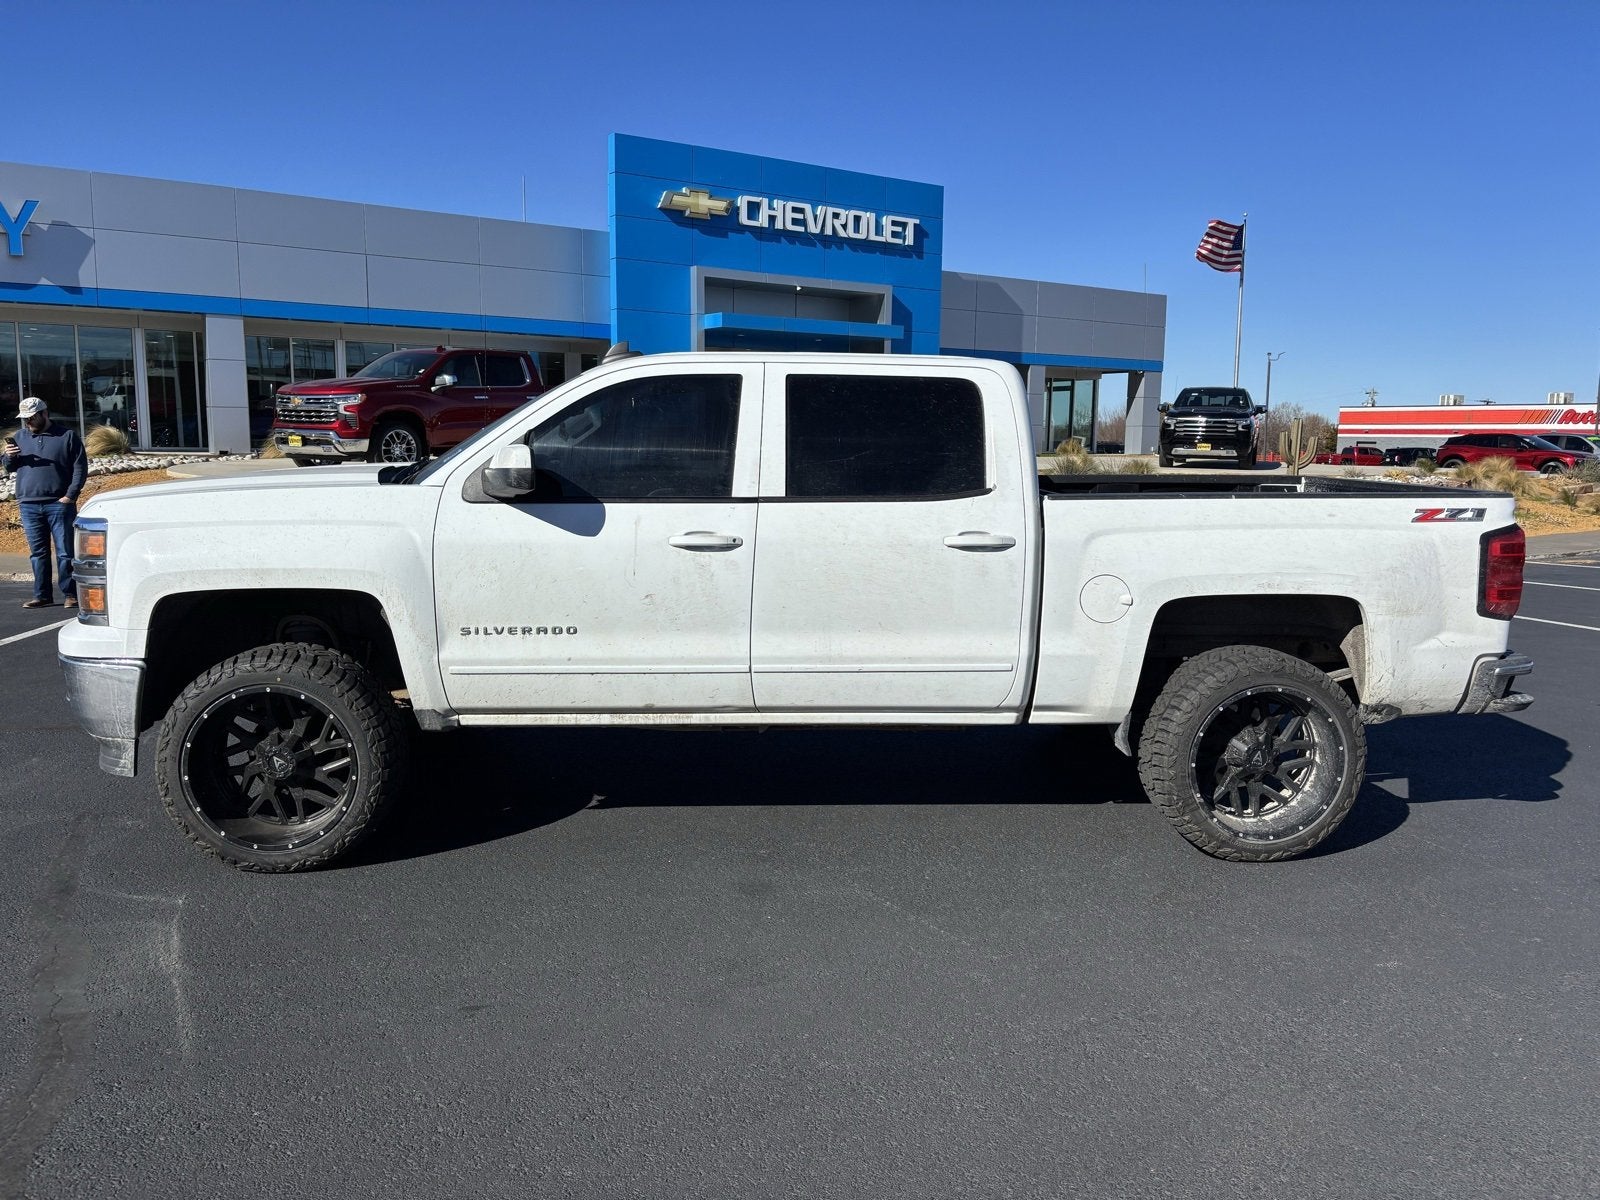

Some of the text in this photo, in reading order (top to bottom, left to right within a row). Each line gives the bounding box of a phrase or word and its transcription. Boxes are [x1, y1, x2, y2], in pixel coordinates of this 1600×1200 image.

[737, 195, 920, 246] CHEVROLET
[1410, 507, 1487, 523] Z71
[459, 625, 578, 637] SILVERADO
